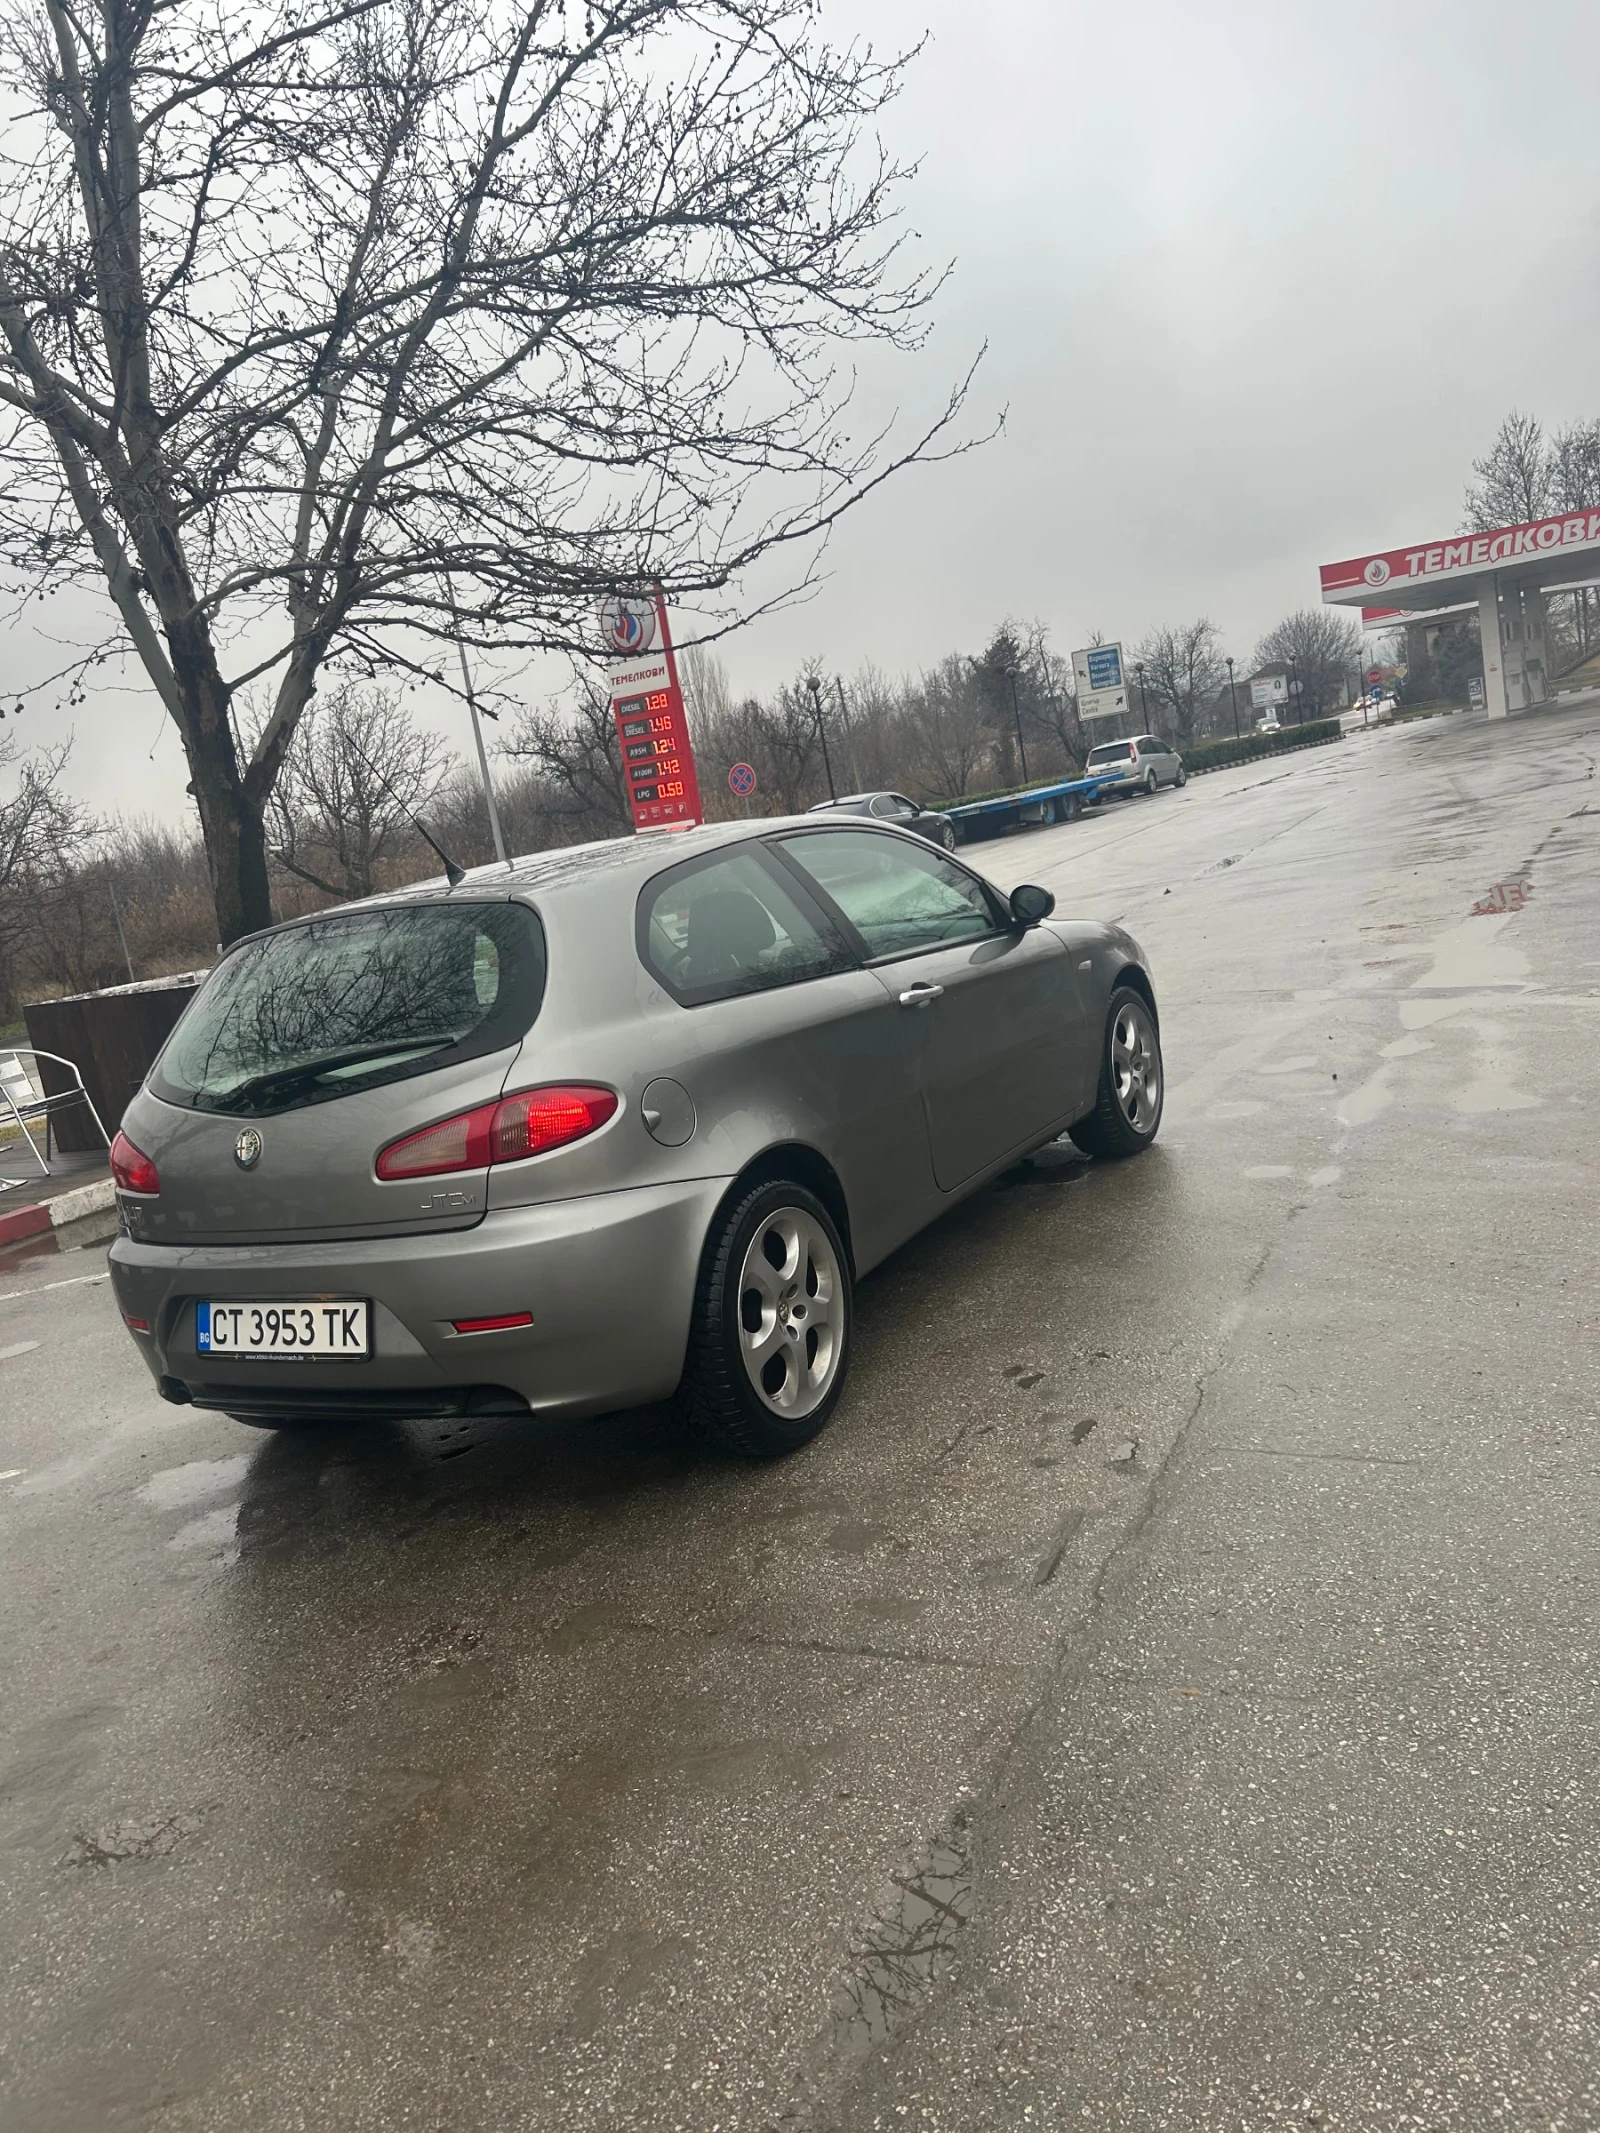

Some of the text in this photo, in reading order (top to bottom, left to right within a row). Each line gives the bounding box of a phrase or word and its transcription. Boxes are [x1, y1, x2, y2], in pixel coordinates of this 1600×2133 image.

[611, 666, 665, 686] ТЕМЕЛКОВИ
[621, 693, 668, 713] DIESEL 1.28
[625, 715, 672, 737] DIESEL 1.46
[653, 737, 676, 755] 1.24
[656, 759, 681, 776] 1.42
[637, 781, 684, 799] LPG 0.58
[200, 1308, 360, 1347] BG CT 3953 TK
